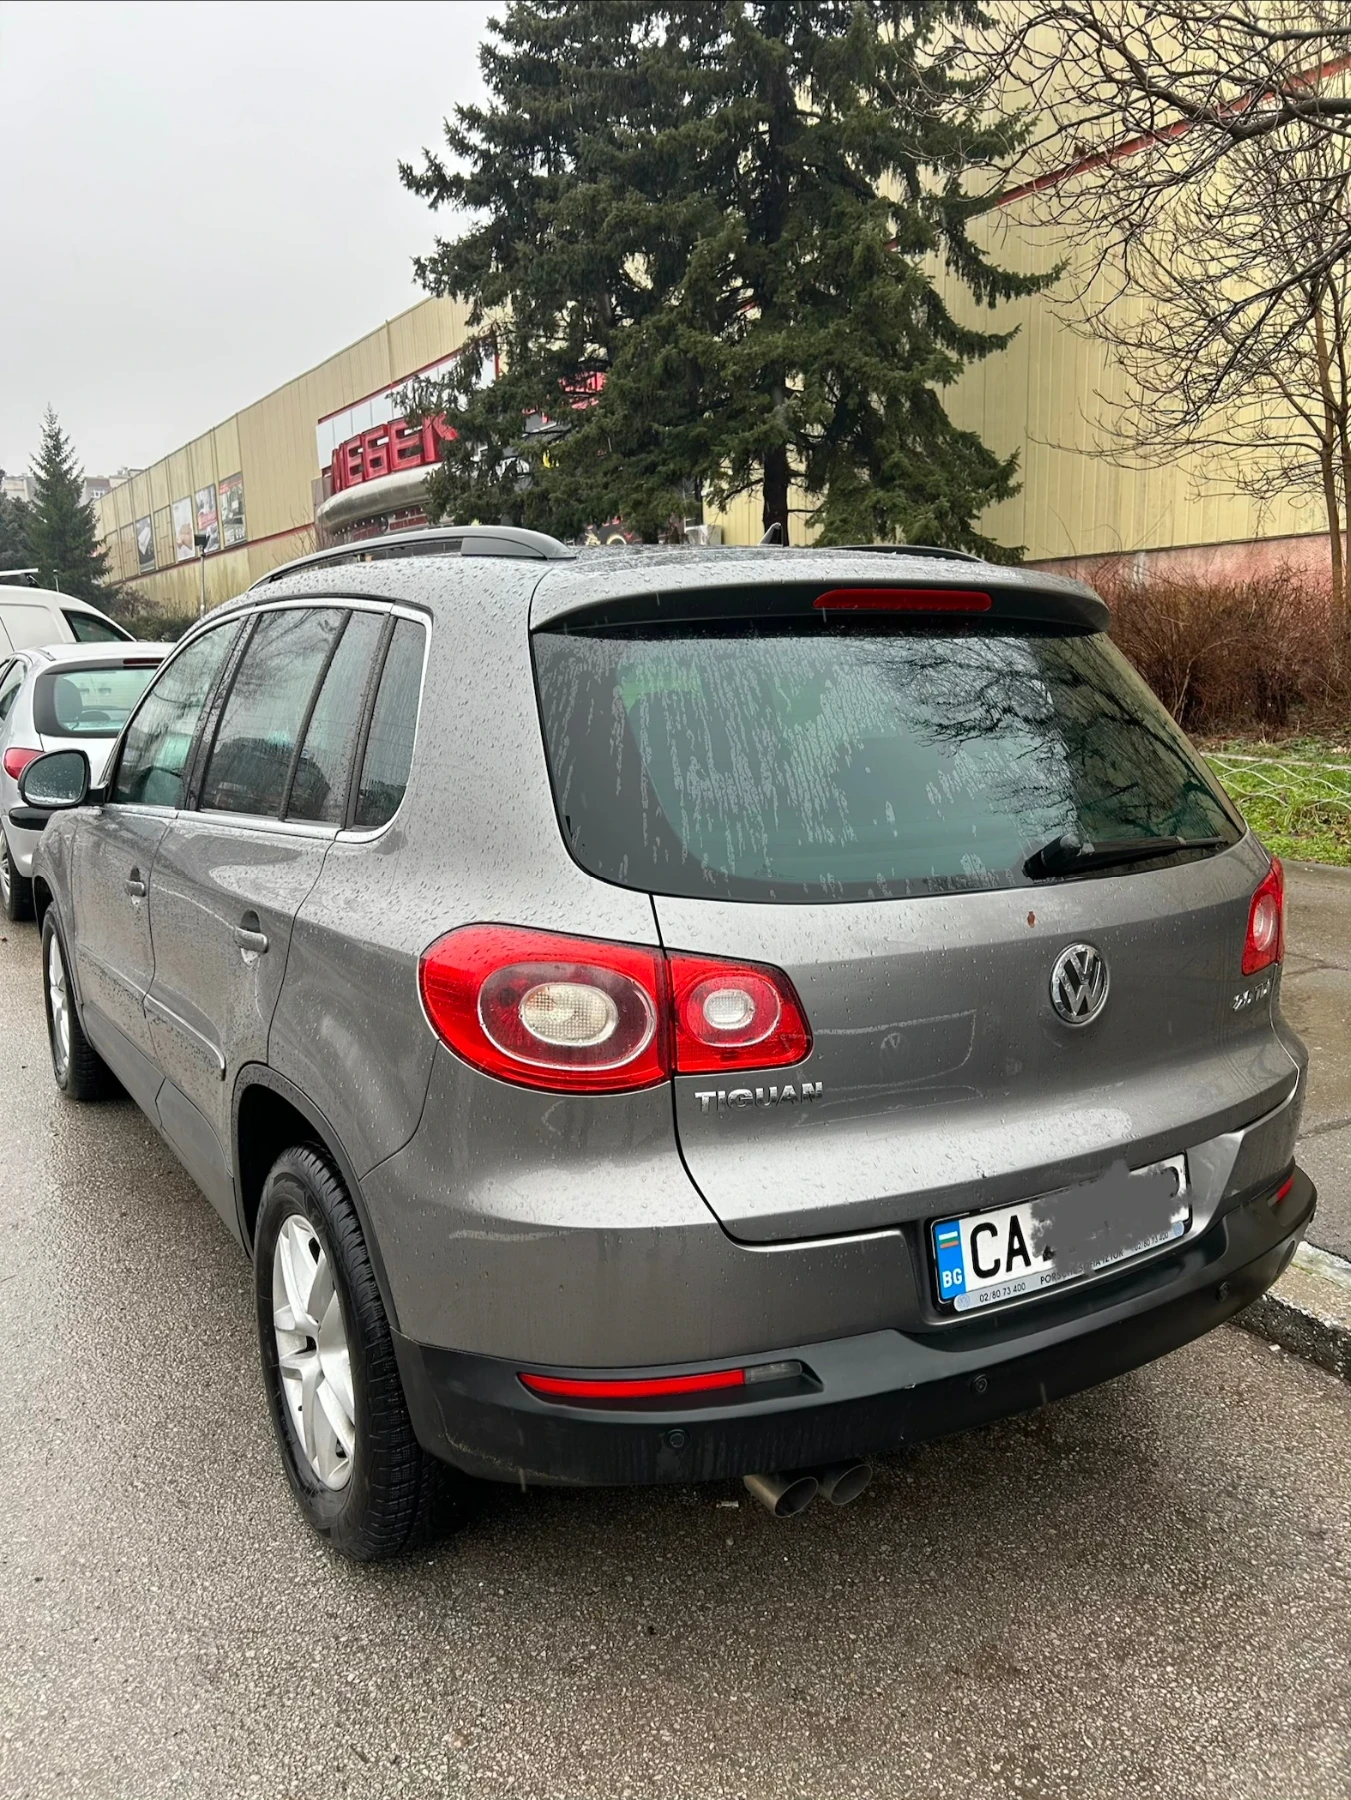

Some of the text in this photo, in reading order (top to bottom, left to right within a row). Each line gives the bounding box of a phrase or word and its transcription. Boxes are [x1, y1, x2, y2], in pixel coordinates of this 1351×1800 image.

[694, 1081, 823, 1112] TIGUAN
[942, 1267, 963, 1289] BG
[1003, 1287, 1012, 1296] 73
[1013, 1282, 1027, 1293] 400
